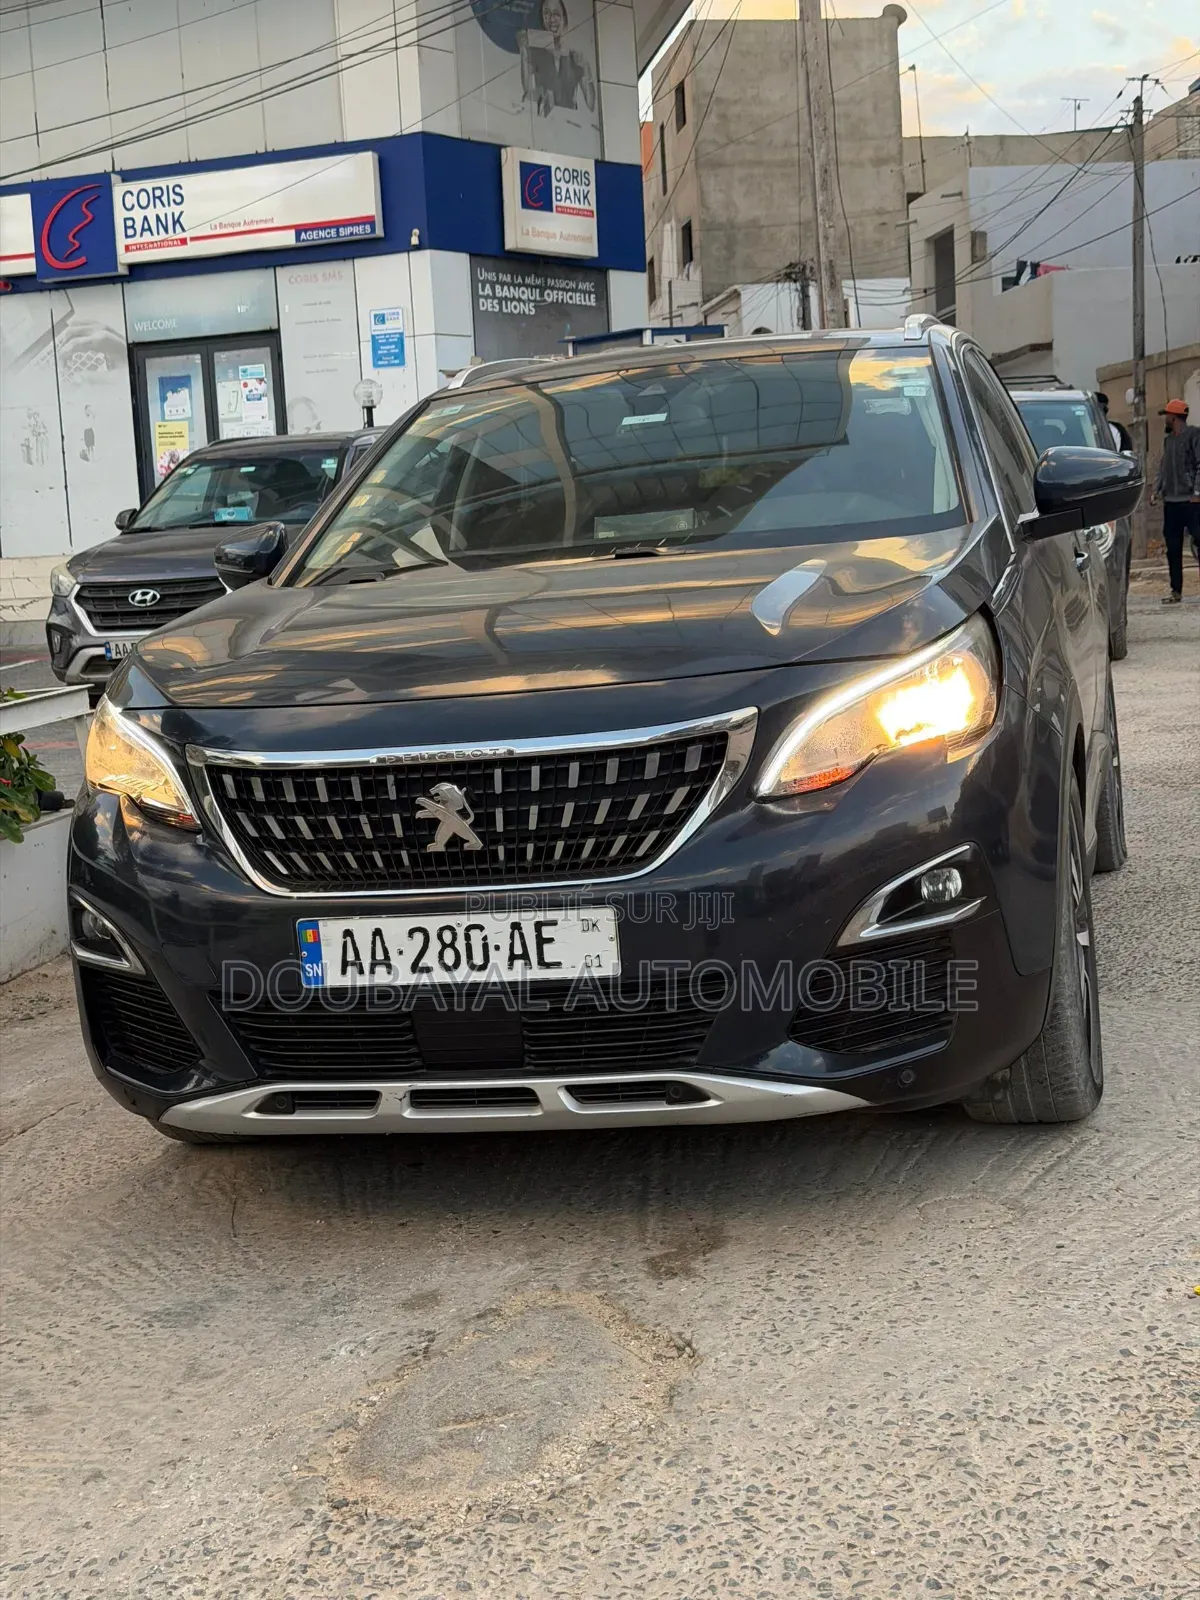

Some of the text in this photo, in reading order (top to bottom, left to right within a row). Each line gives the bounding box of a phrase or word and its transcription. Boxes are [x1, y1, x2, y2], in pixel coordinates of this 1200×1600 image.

[554, 166, 591, 187] CORIS
[121, 183, 185, 212] CORIS
[554, 185, 591, 206] BANK
[123, 210, 186, 239] BANK
[219, 221, 242, 230] Banque
[243, 217, 275, 227] Autrement
[300, 224, 371, 240] AGENCE SIPRES
[128, 240, 182, 251] INTERNATIONAL
[478, 283, 493, 297] LA
[543, 289, 597, 306] OFFICIELLE
[479, 298, 536, 315] DES LIONS
[133, 318, 178, 332] WELCOME
[385, 748, 500, 764] PEUGEOT
[580, 918, 602, 932] DK
[305, 963, 323, 977] SN
